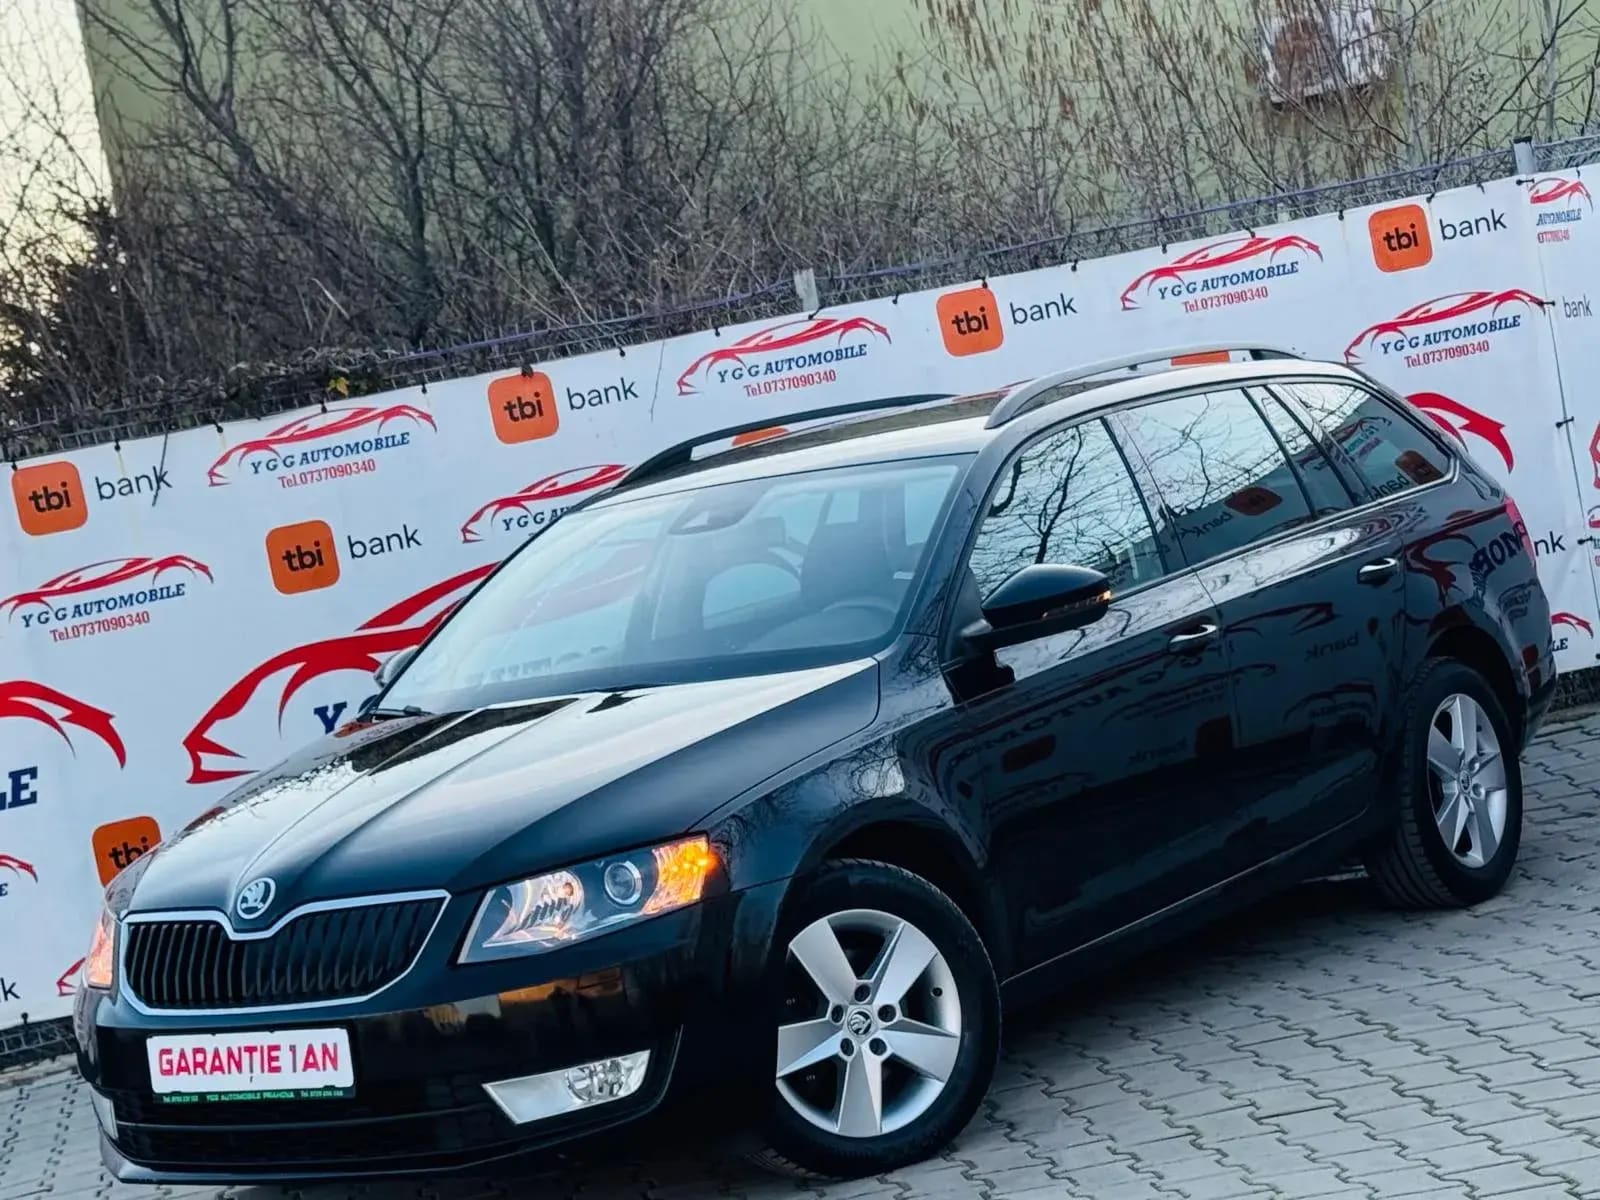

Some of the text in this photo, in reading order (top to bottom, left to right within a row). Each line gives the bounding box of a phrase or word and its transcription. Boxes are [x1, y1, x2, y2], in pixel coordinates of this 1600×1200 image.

[1383, 223, 1419, 251] tbi
[1439, 208, 1508, 240] bank
[1201, 261, 1299, 292] AUTOMOBILE
[951, 292, 1078, 336] tbi bank
[1562, 293, 1593, 319] bank
[1422, 315, 1521, 347] AUTOMOBILE
[763, 343, 868, 375] AUTOMOBILE
[503, 377, 639, 422] tbi bank
[299, 431, 410, 466] AUTOMOBILE
[28, 465, 172, 513] tbi bank
[282, 524, 422, 572] tbi bank
[1534, 530, 1566, 557] nk
[71, 583, 186, 619] AUTOMOBILE
[302, 1042, 339, 1073] AN
